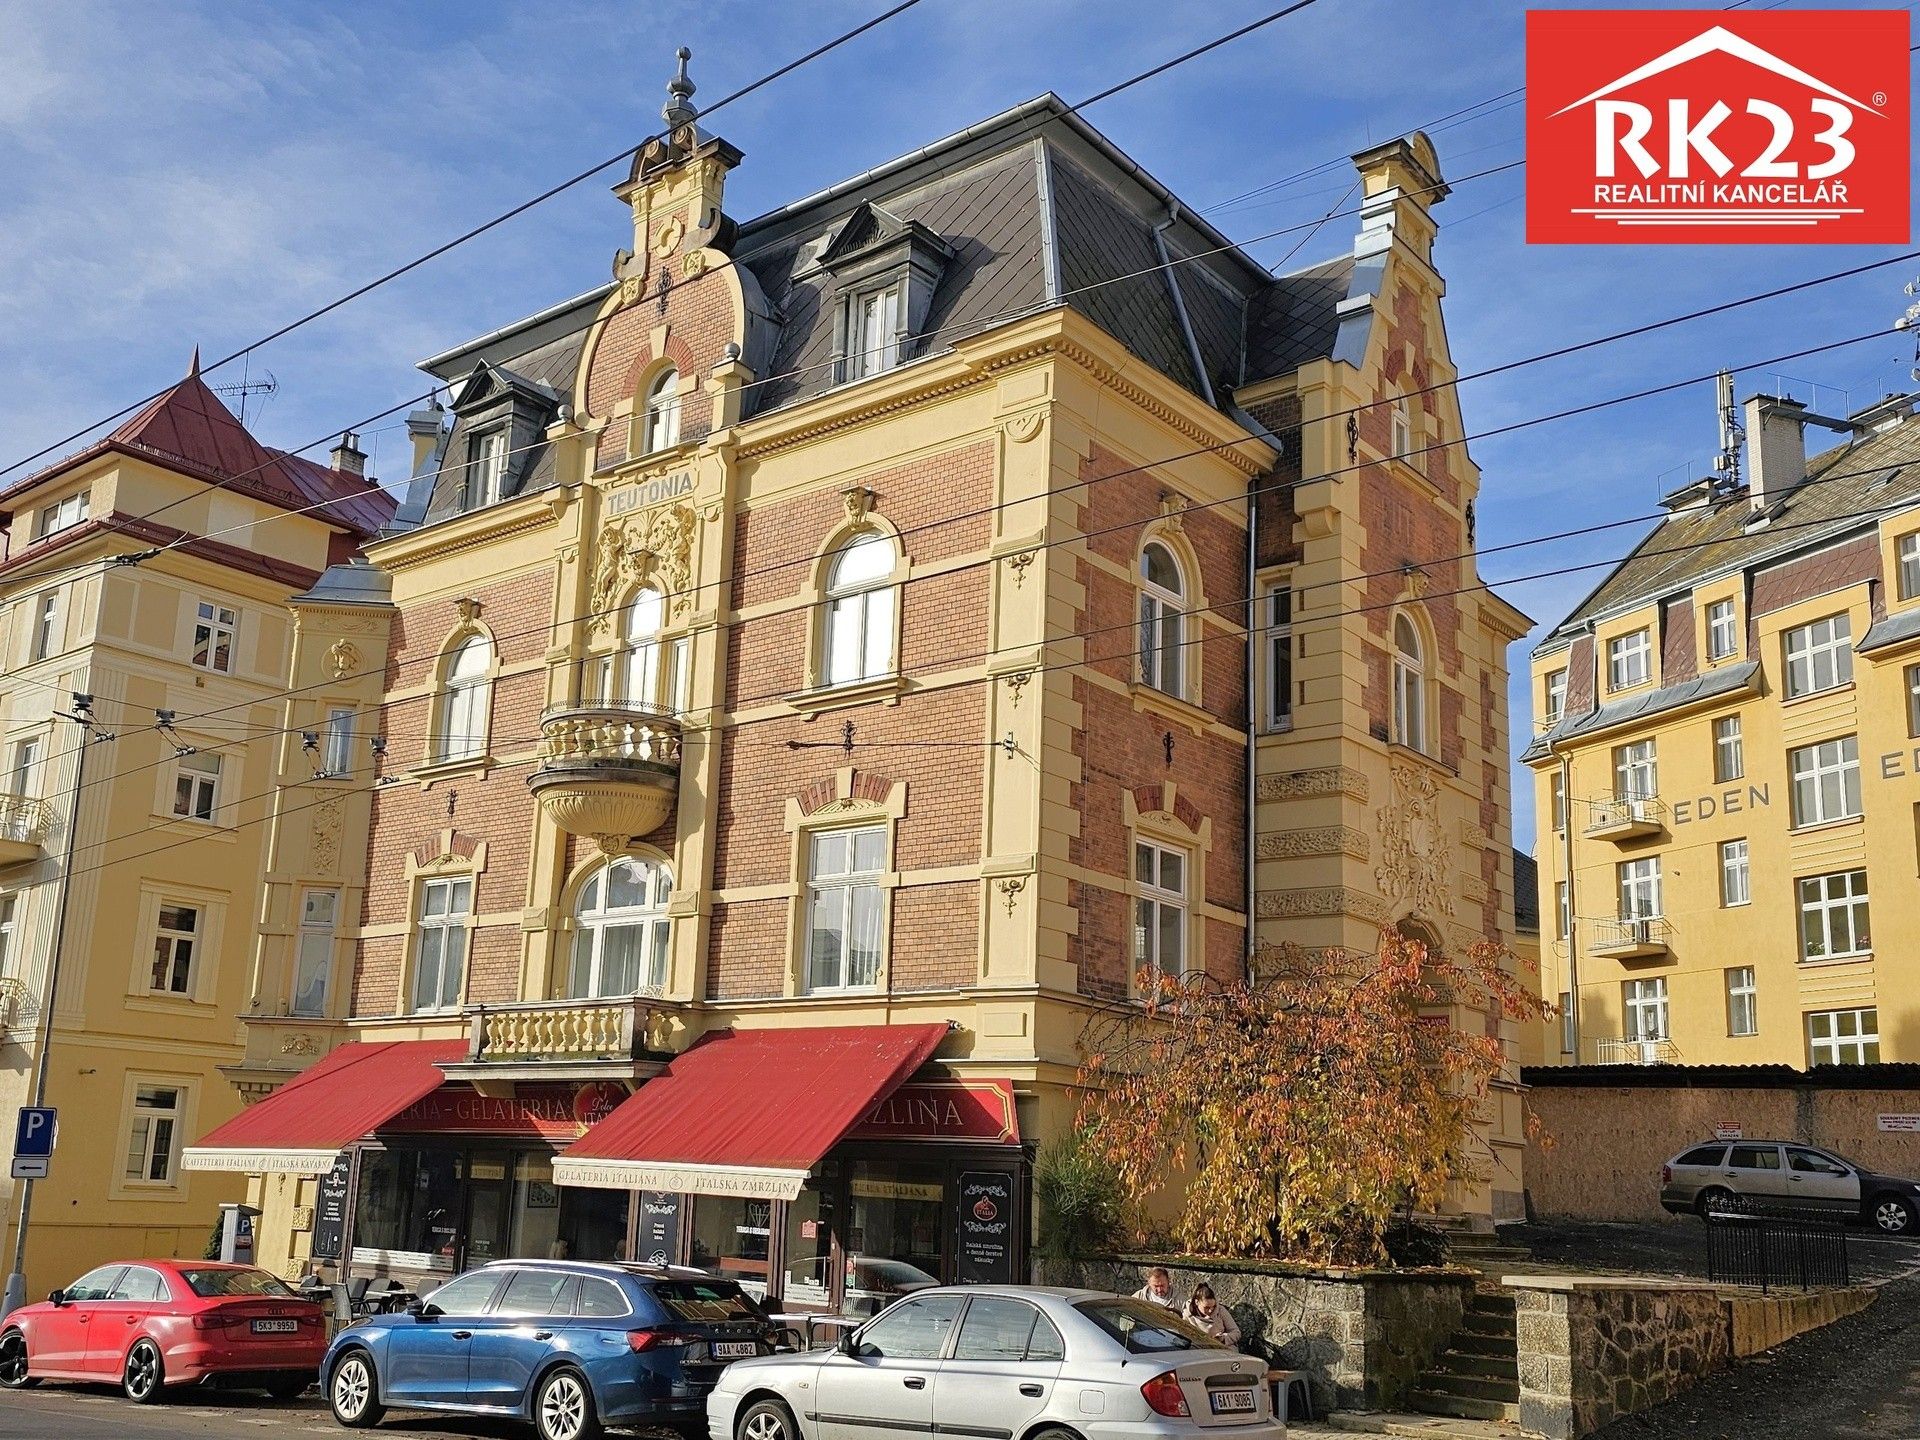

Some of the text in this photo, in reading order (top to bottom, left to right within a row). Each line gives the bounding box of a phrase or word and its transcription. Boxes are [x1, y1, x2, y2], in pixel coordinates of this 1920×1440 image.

[608, 472, 693, 515] TEUTONIA
[1674, 783, 1770, 825] EDEN
[456, 1099, 567, 1121] GELATERIA
[863, 1099, 965, 1126] ZLINA
[26, 1112, 45, 1139] P
[558, 1169, 609, 1183] GELATERIA
[611, 1171, 658, 1186] ITALIANA
[741, 1180, 797, 1195] ZMRZLINA
[241, 1219, 250, 1232] P
